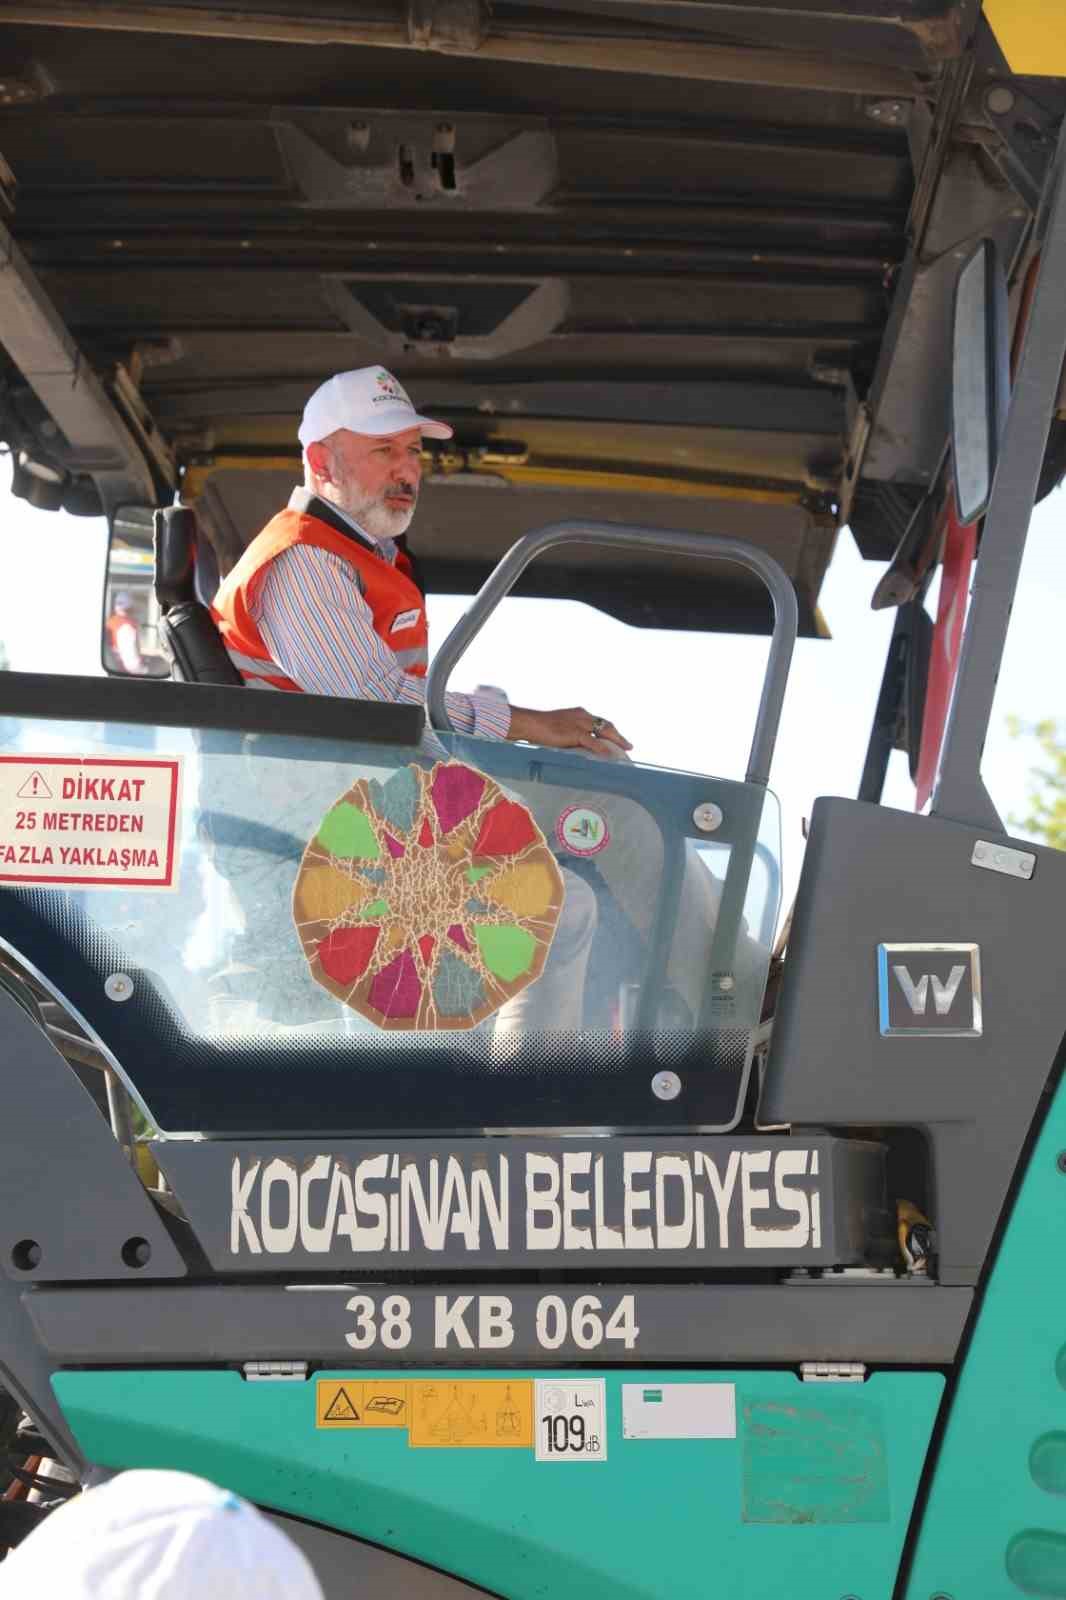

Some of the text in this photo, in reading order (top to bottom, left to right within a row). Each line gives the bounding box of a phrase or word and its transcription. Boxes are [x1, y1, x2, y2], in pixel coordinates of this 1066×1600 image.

[62, 772, 145, 801] DİKKAT
[16, 811, 143, 832] 25 METREDEN
[59, 847, 159, 871] YAKLAŞMA
[344, 1294, 640, 1350] 38 KB 064
[542, 1415, 585, 1452] 109
